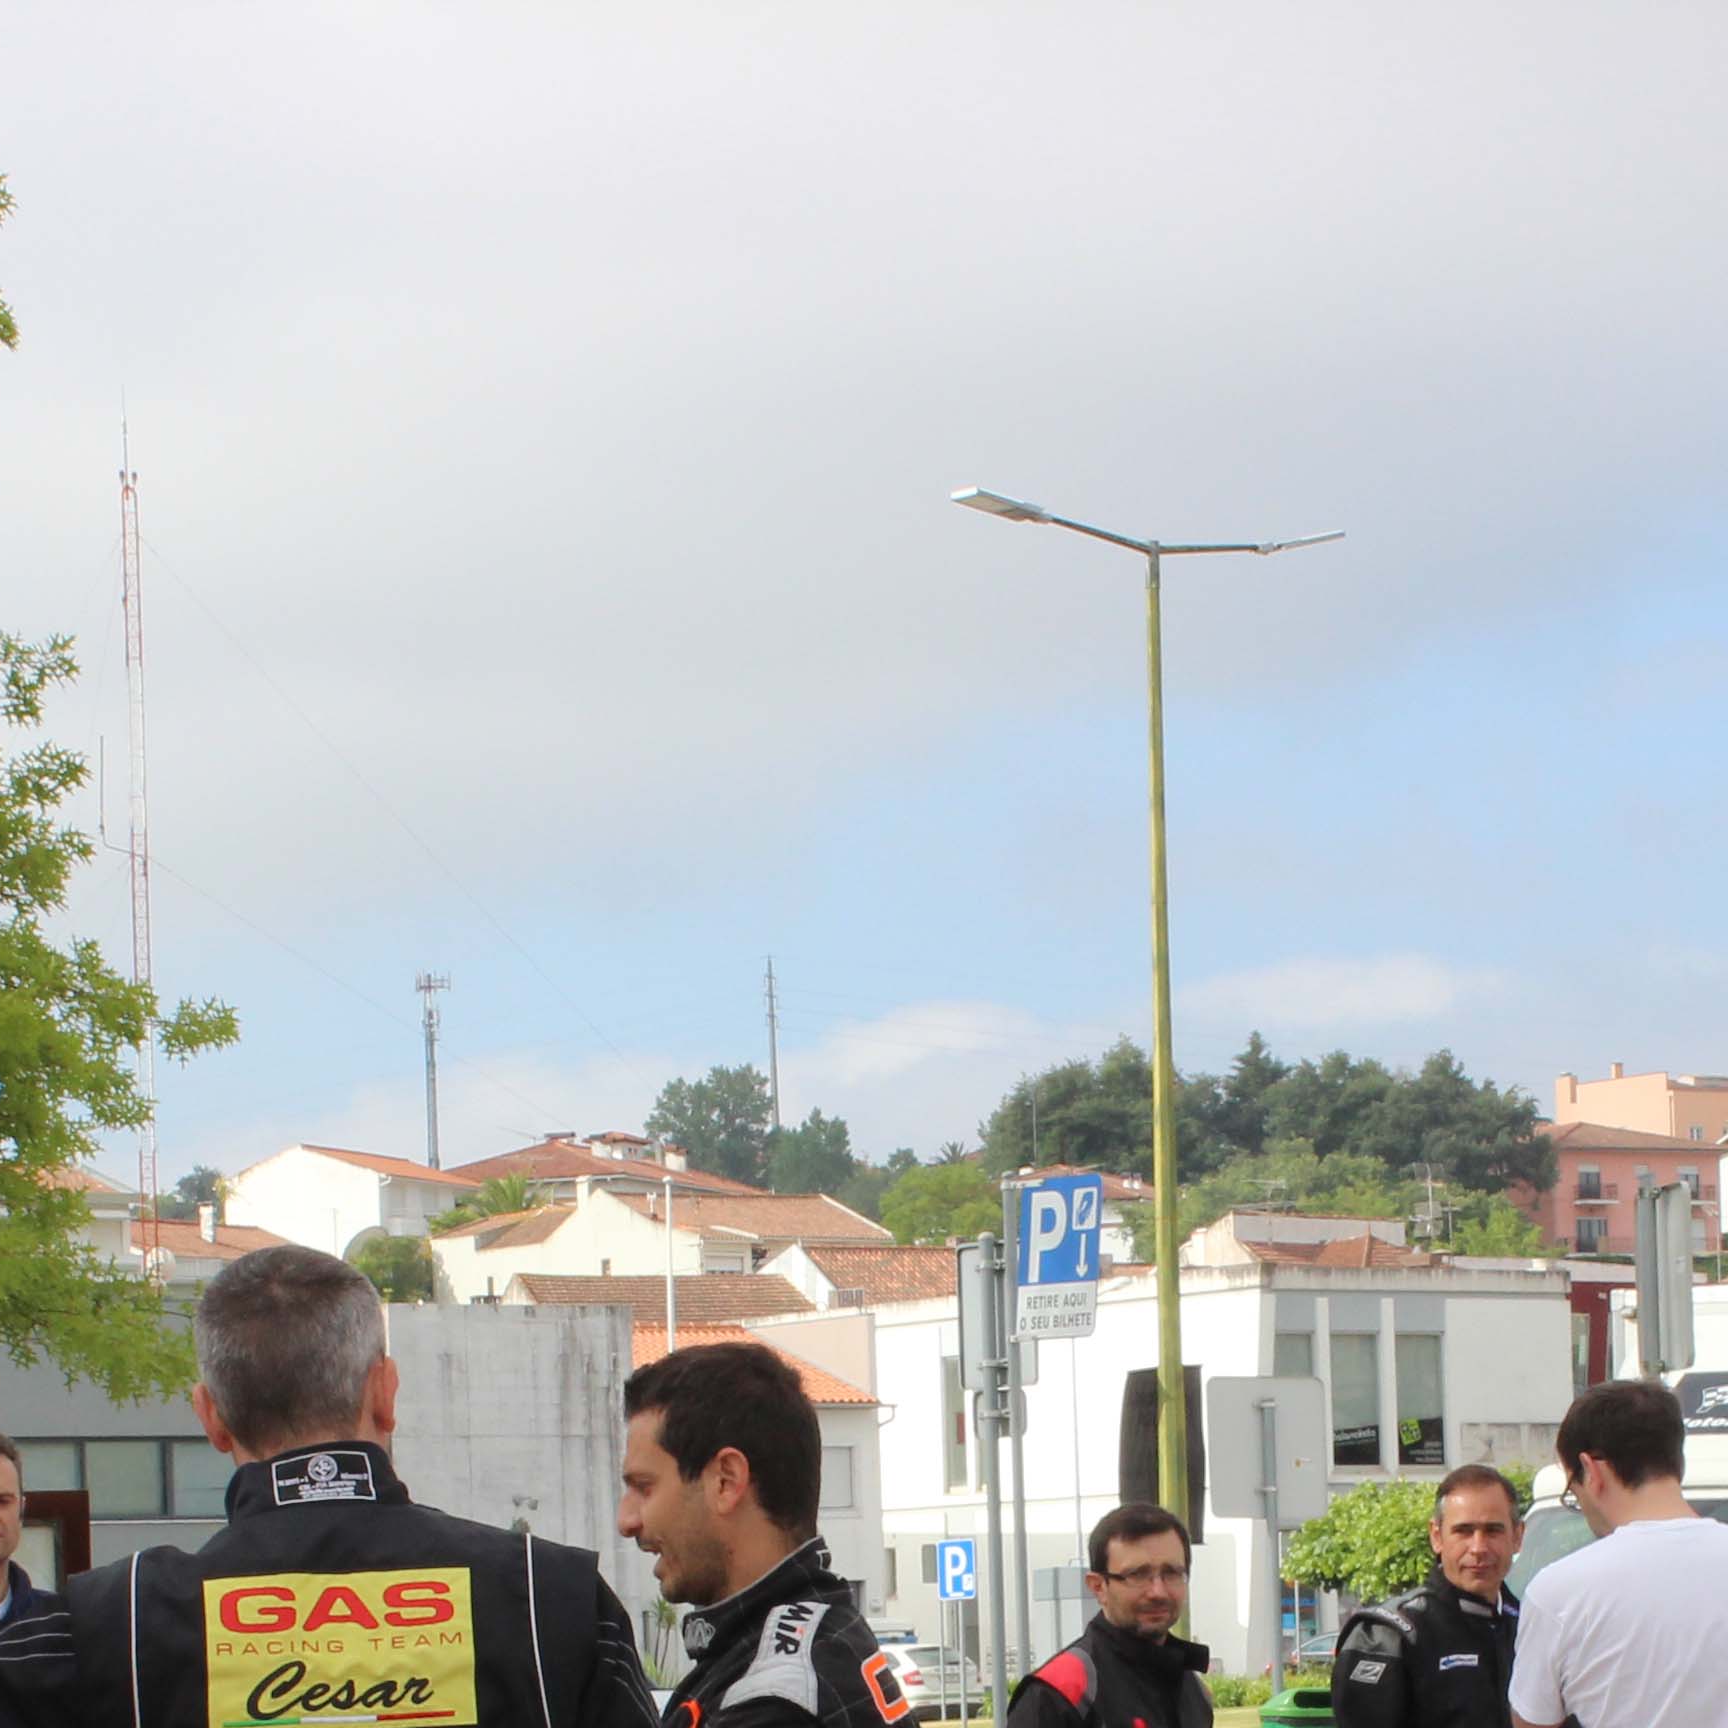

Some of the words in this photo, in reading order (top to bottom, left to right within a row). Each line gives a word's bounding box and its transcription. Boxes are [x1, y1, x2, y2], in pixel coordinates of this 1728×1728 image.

[1028, 1190, 1068, 1284] P
[1020, 1317, 1027, 1331] O
[1031, 1315, 1050, 1330] SEU
[1053, 1312, 1092, 1329] BILHETE
[1026, 1295, 1059, 1310] RETIRE
[1063, 1292, 1088, 1308] AQUI
[944, 1546, 968, 1593] P
[219, 1581, 455, 1634] GAS
[216, 1639, 345, 1656] RACING
[367, 1631, 464, 1651] TEAM
[246, 1660, 434, 1721] Cesar
